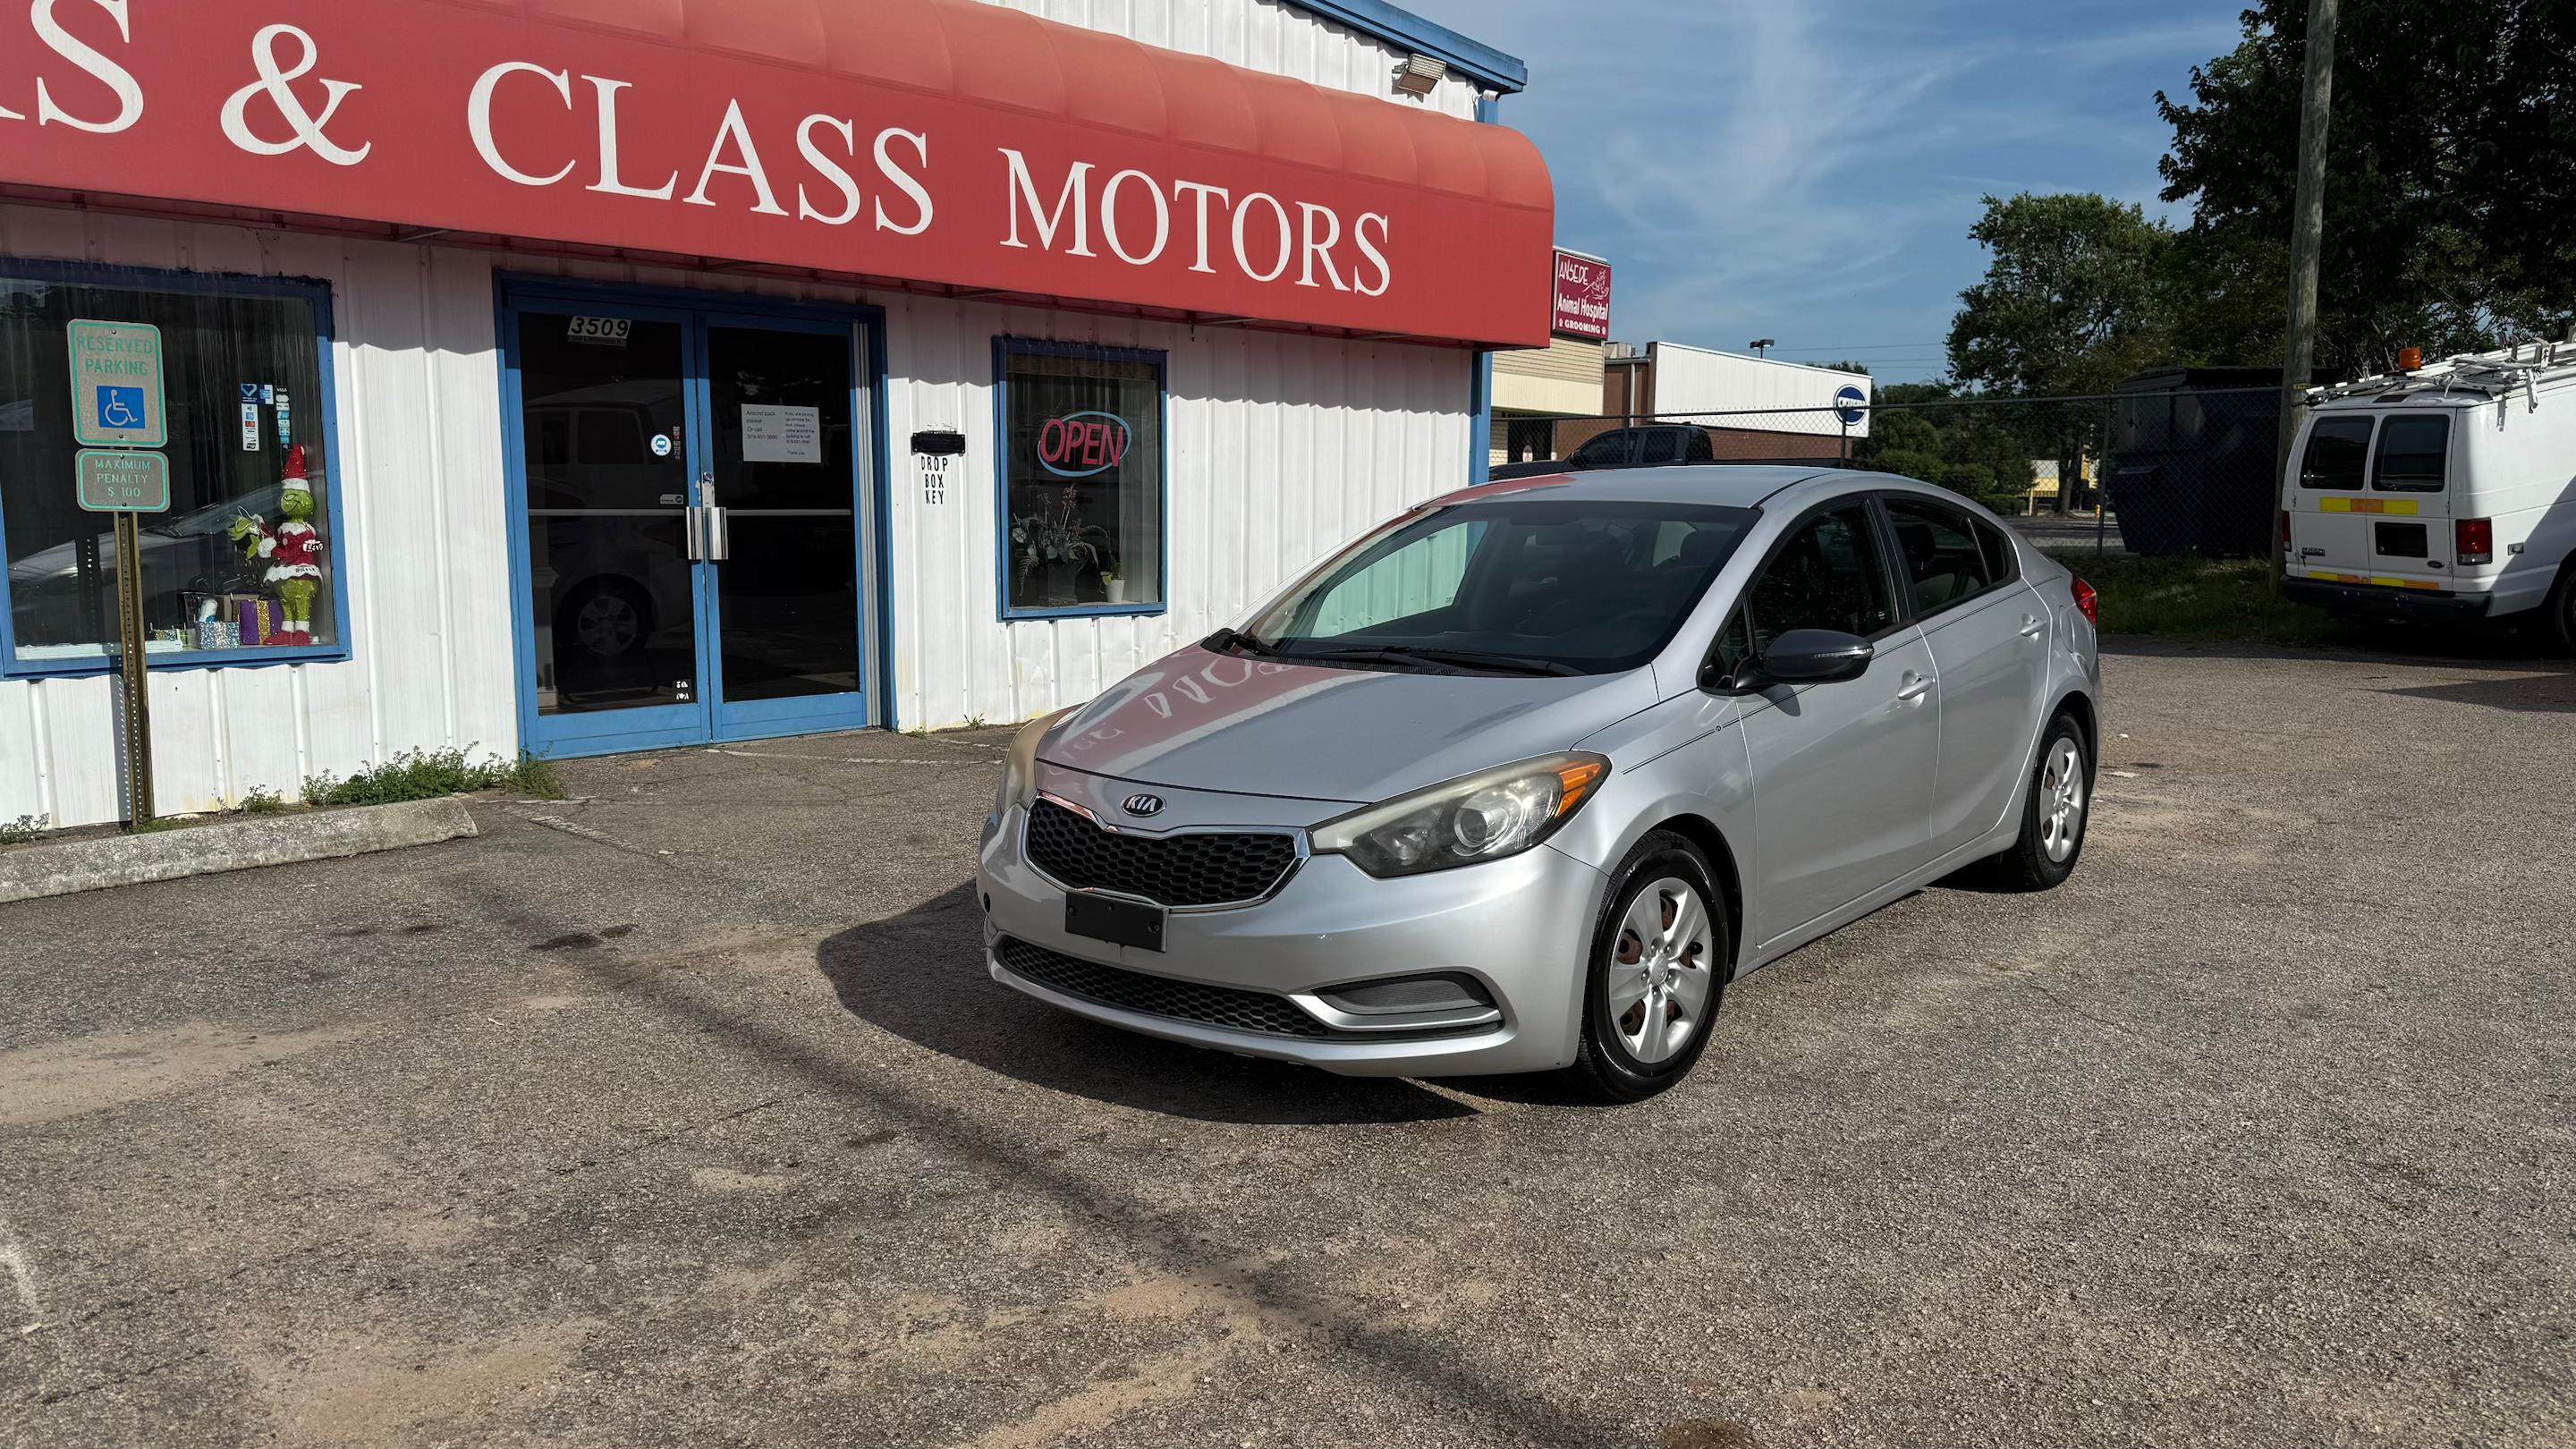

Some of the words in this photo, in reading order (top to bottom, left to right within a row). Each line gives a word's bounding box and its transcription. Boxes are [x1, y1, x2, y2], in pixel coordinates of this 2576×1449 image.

[0, 0, 144, 133] S
[220, 23, 371, 166] &
[467, 61, 934, 235] CLASS
[997, 147, 1391, 297] MOTORS
[1557, 292, 1580, 316] Animal
[1580, 294, 1608, 323] Hospital
[571, 317, 629, 336] 3509
[1564, 318, 1600, 335] GROOMING
[77, 335, 154, 354] RESERVED
[85, 358, 148, 377] PARKING
[1040, 418, 1124, 468] OPEN
[95, 459, 150, 470] MAXIMUM
[921, 456, 948, 471] DROP
[97, 473, 148, 485] PENALTY
[925, 473, 945, 488] BOX
[107, 487, 114, 497] $
[122, 487, 141, 497] 100
[925, 489, 944, 504] KEY
[1126, 796, 1157, 812] KIA
